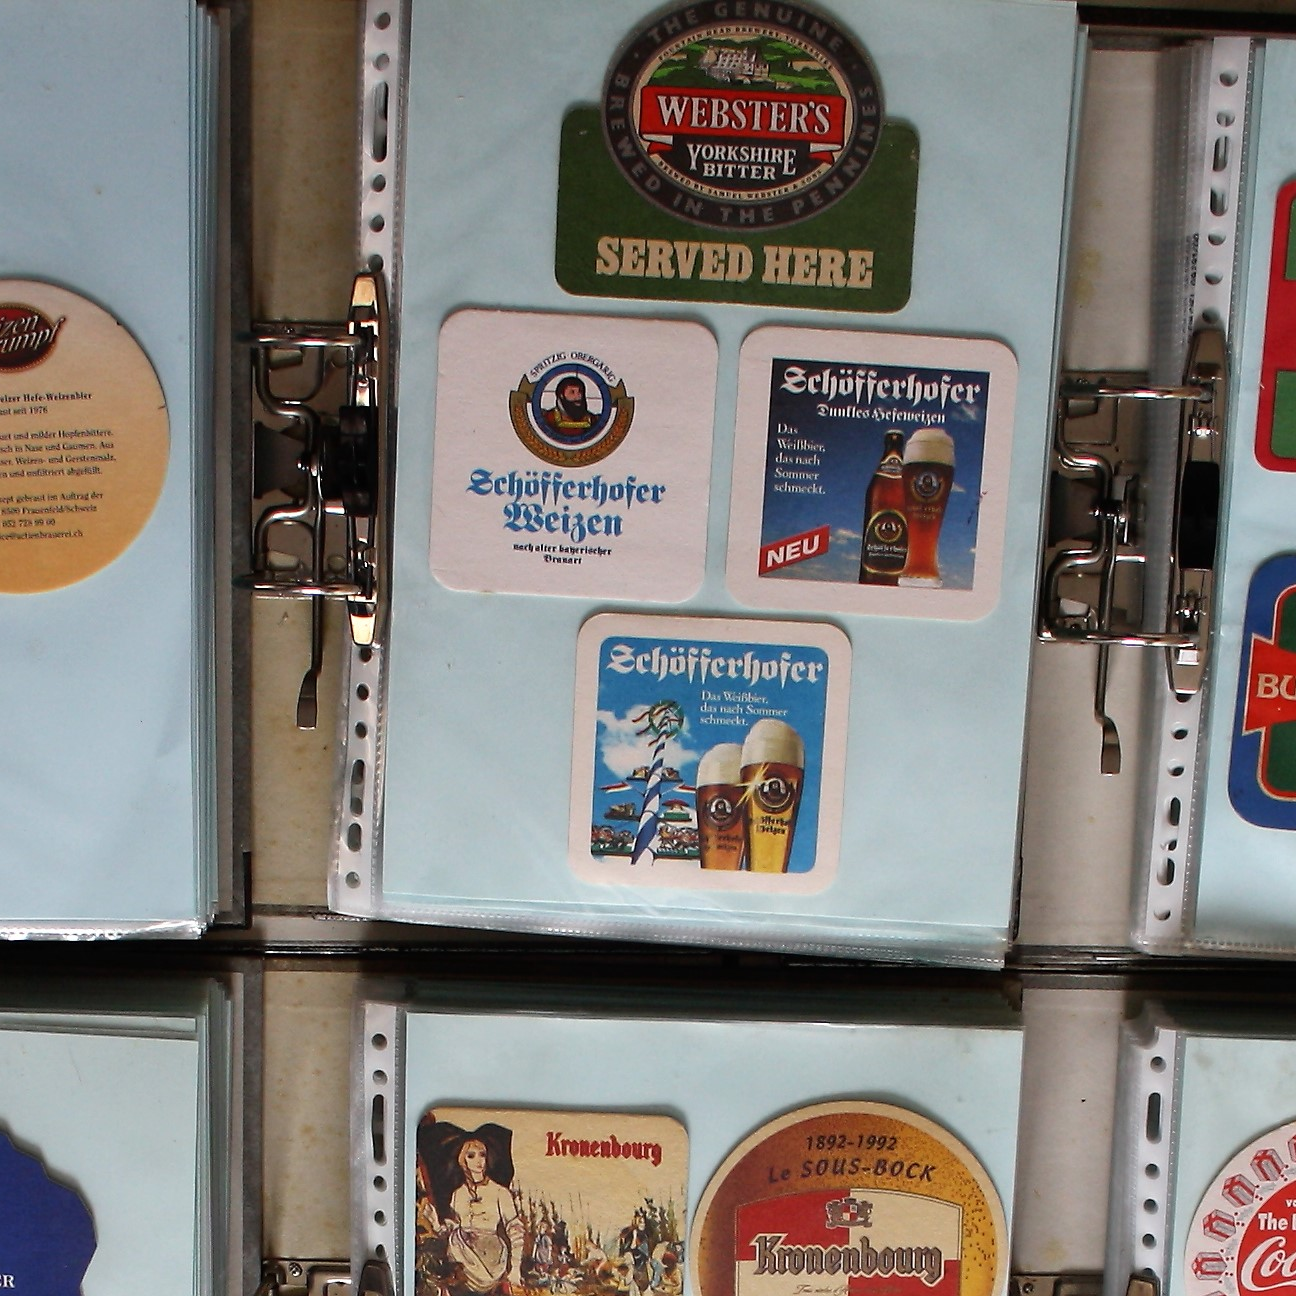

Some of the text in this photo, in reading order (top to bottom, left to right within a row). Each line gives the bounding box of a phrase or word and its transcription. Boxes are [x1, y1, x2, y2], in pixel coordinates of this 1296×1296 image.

[649, 0, 843, 51] THE GENUINE
[657, 94, 831, 135] WEBSTER'S
[610, 75, 875, 223] BREWED IN THE PENNINES
[687, 144, 797, 177] YORKSHIRE
[703, 164, 776, 180] BITTER
[596, 236, 874, 289] SERVED HERE
[780, 366, 981, 410] Schöfferhofer
[777, 424, 798, 435] Das
[817, 404, 946, 426] Dunkles Hefeweizen
[466, 468, 666, 509] Schöfferhofer
[774, 468, 819, 481] Sommer
[503, 501, 623, 543] Weizen
[766, 535, 820, 568] NEU
[607, 644, 824, 689] Schöfferhofer
[545, 1131, 662, 1167] Kronenbourg
[806, 1135, 898, 1152] 1892-1992
[767, 1158, 937, 1185] Le SOUS-BOCK
[1258, 1213, 1288, 1230] The
[750, 1234, 943, 1286] Kronenbourg
